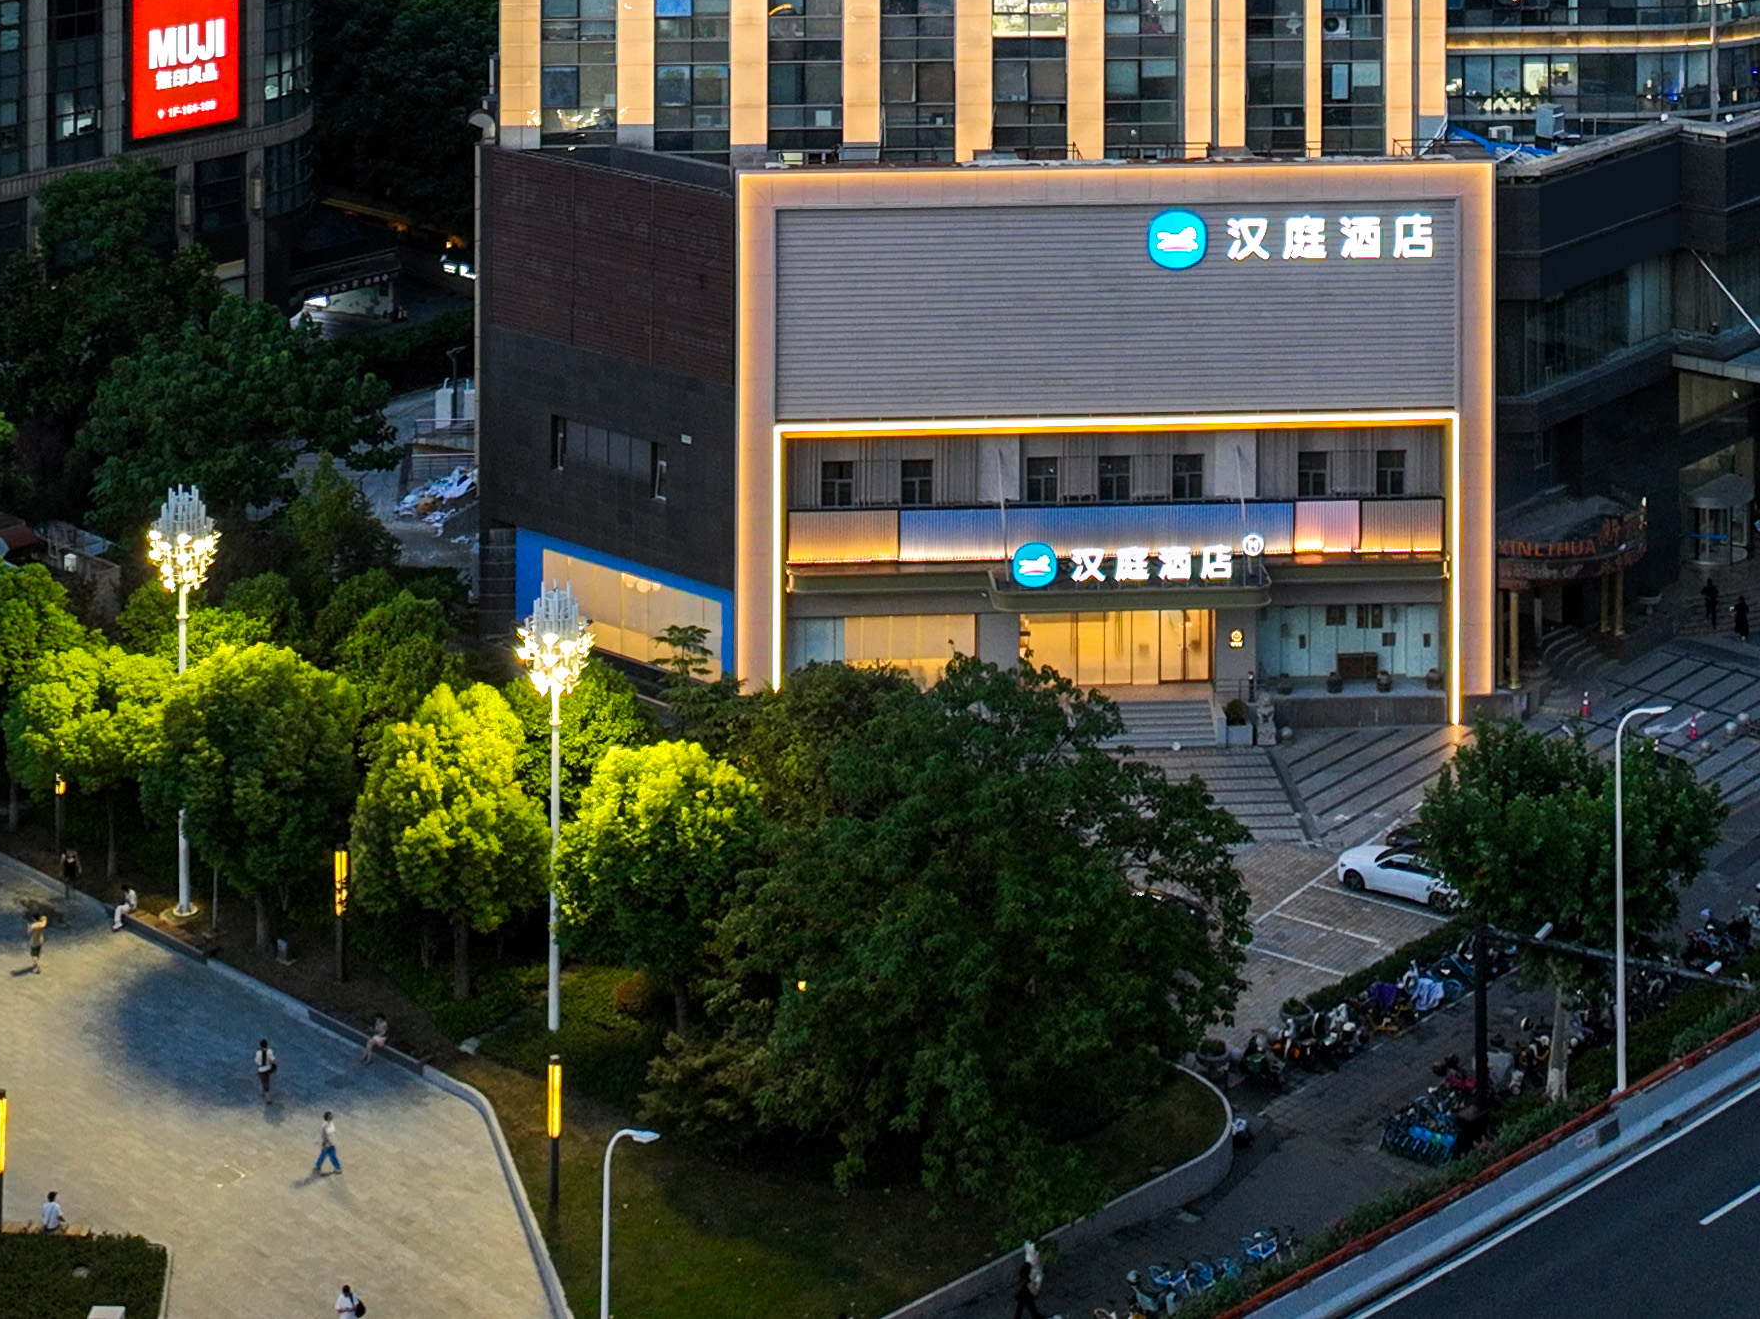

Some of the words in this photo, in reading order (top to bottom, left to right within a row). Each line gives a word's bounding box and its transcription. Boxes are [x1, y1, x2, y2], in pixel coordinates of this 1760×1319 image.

[148, 18, 226, 69] MUJI
[1227, 214, 1433, 260] 汉庭酒店
[1071, 544, 1233, 582] 汉庭酒店
